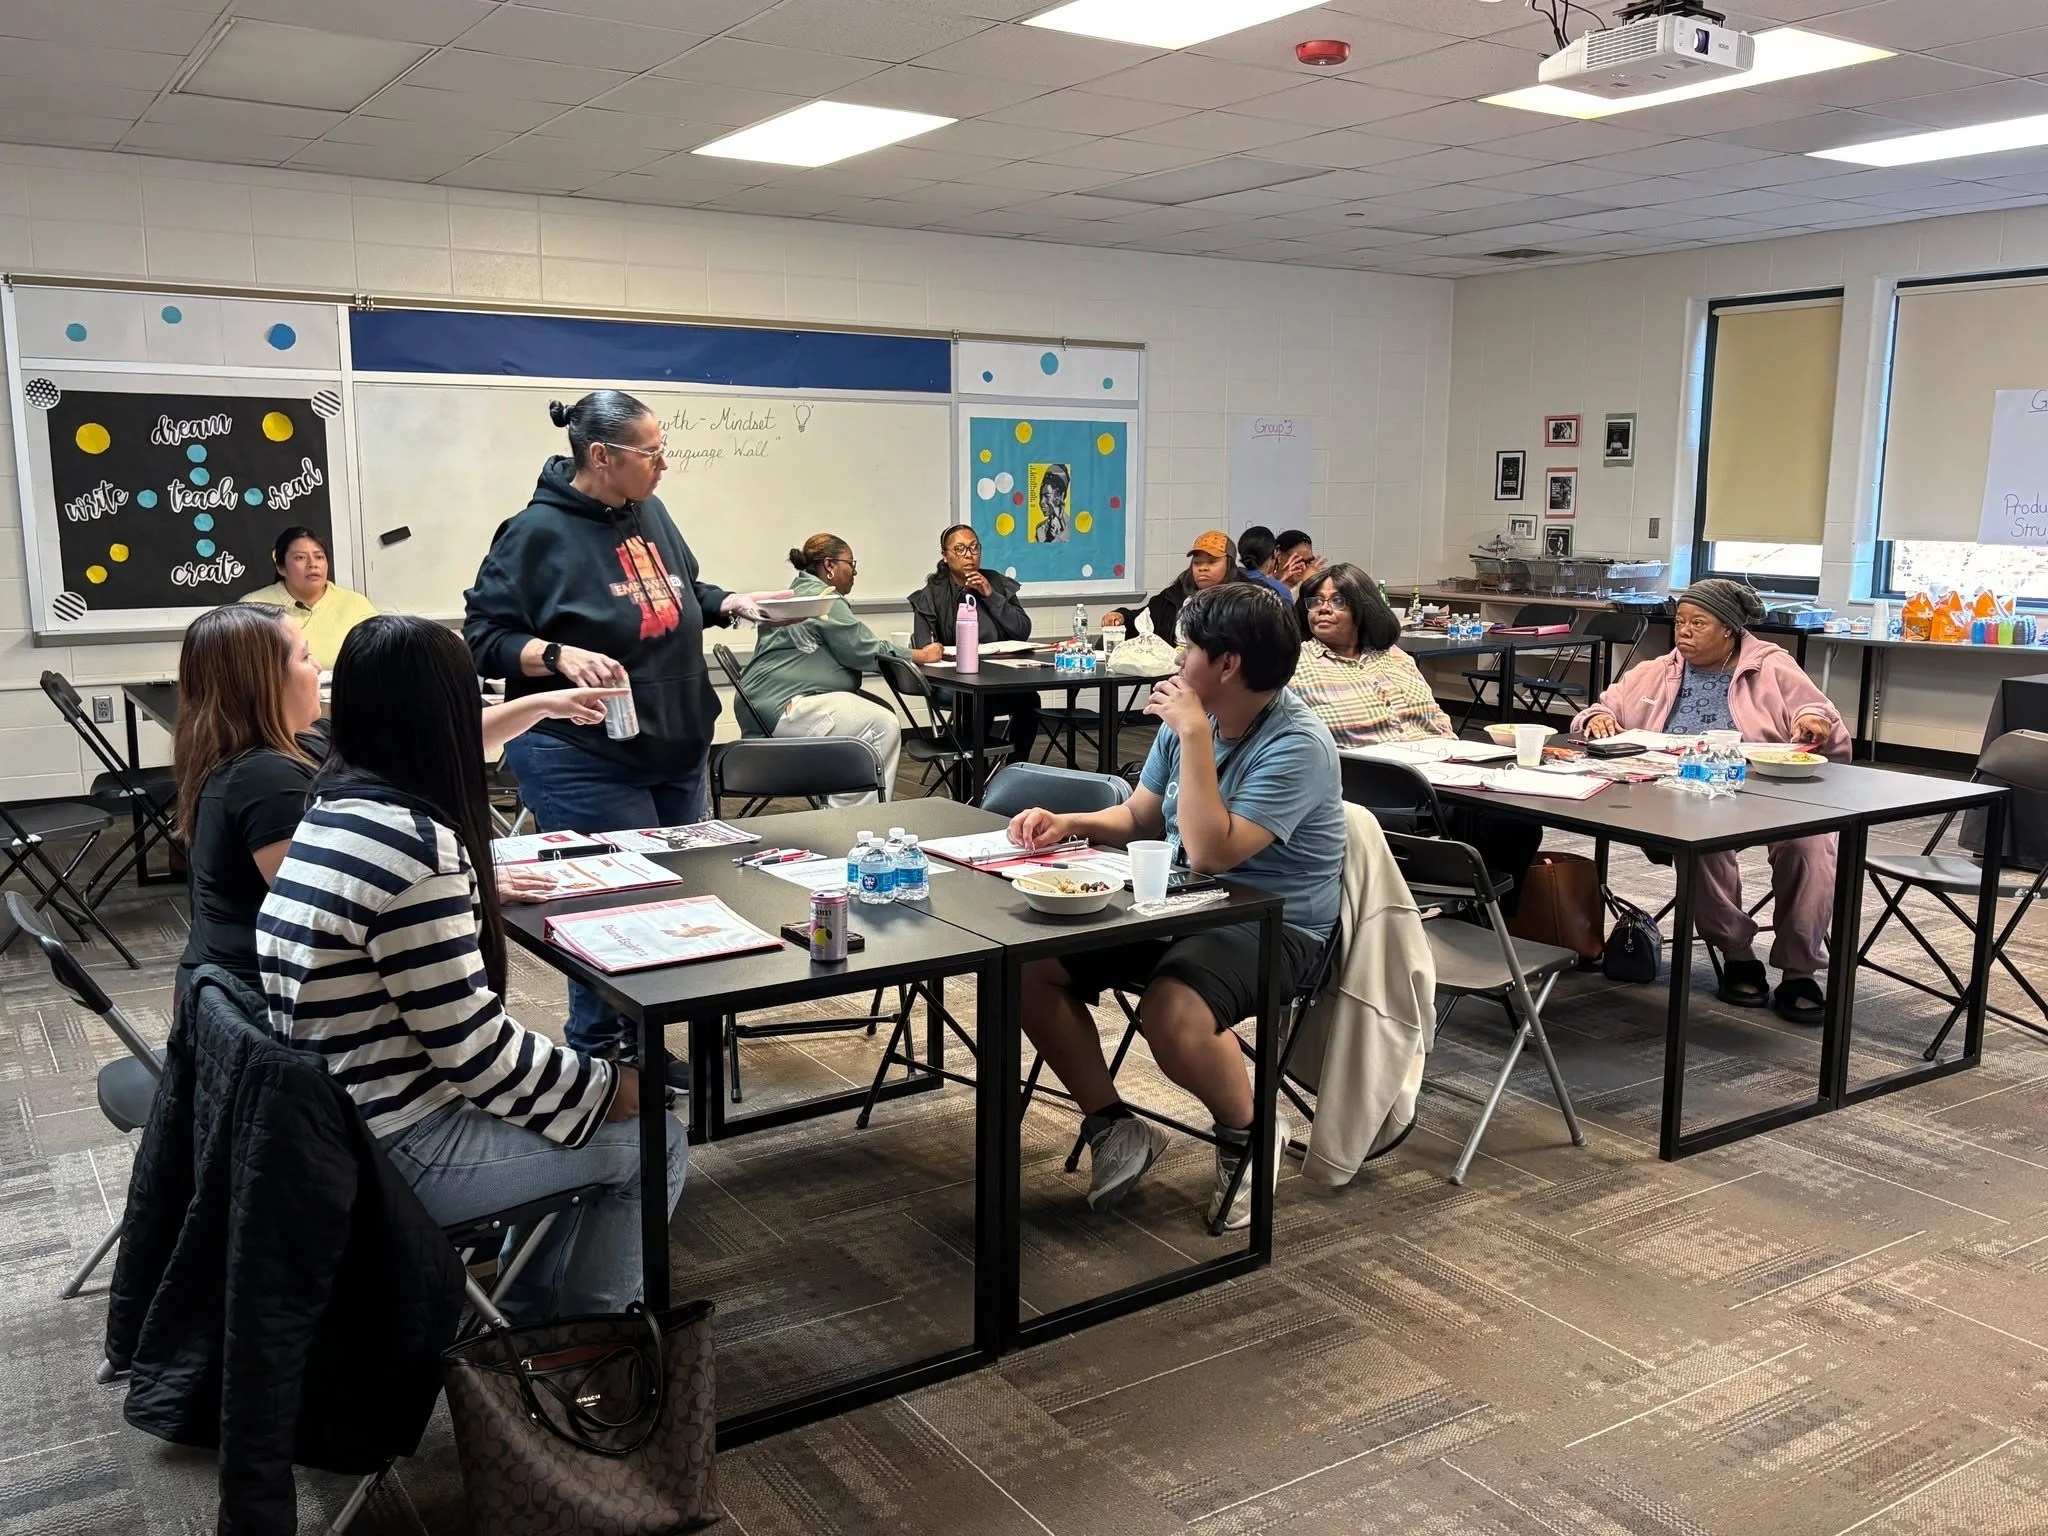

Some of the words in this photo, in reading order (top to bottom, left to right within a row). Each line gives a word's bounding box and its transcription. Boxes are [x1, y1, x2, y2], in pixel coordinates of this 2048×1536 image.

[151, 413, 232, 446] dream
[710, 407, 776, 431] Mindset
[1254, 417, 1284, 442] Group
[733, 437, 769, 457] Wall
[65, 480, 129, 521] write
[167, 476, 238, 513] teach
[268, 457, 322, 510] read
[171, 551, 245, 587] create
[615, 575, 681, 594] EMPWEED
